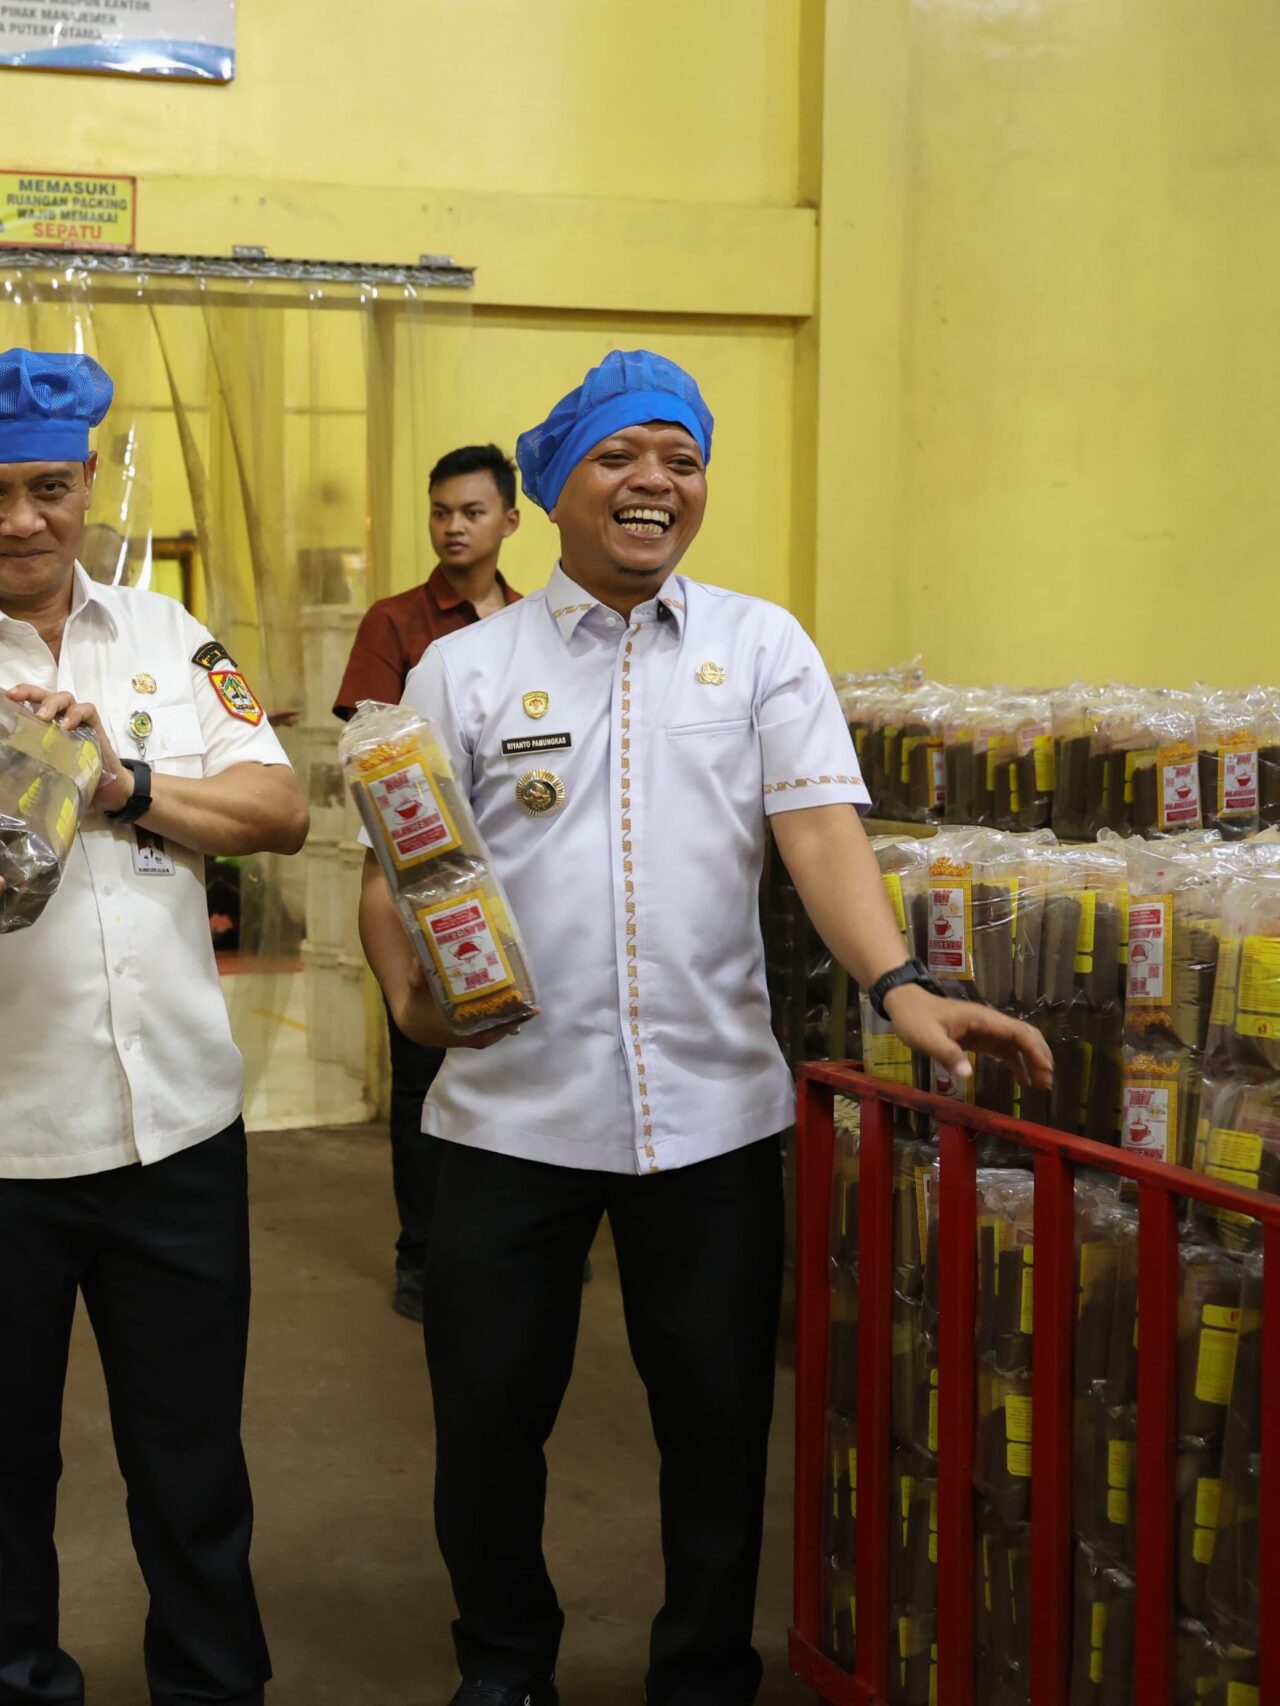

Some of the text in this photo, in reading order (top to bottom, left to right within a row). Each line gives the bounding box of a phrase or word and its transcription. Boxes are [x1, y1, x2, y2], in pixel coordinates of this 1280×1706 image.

[1, 6, 36, 18] PIHAK
[18, 179, 117, 196] MEMASUKI
[7, 193, 127, 211] RUANGAN PACKING
[17, 208, 118, 224] WAJIB MEMAKAI
[33, 222, 102, 240] SEPATU
[506, 737, 567, 751] RIYANTO PAMUNGKAS
